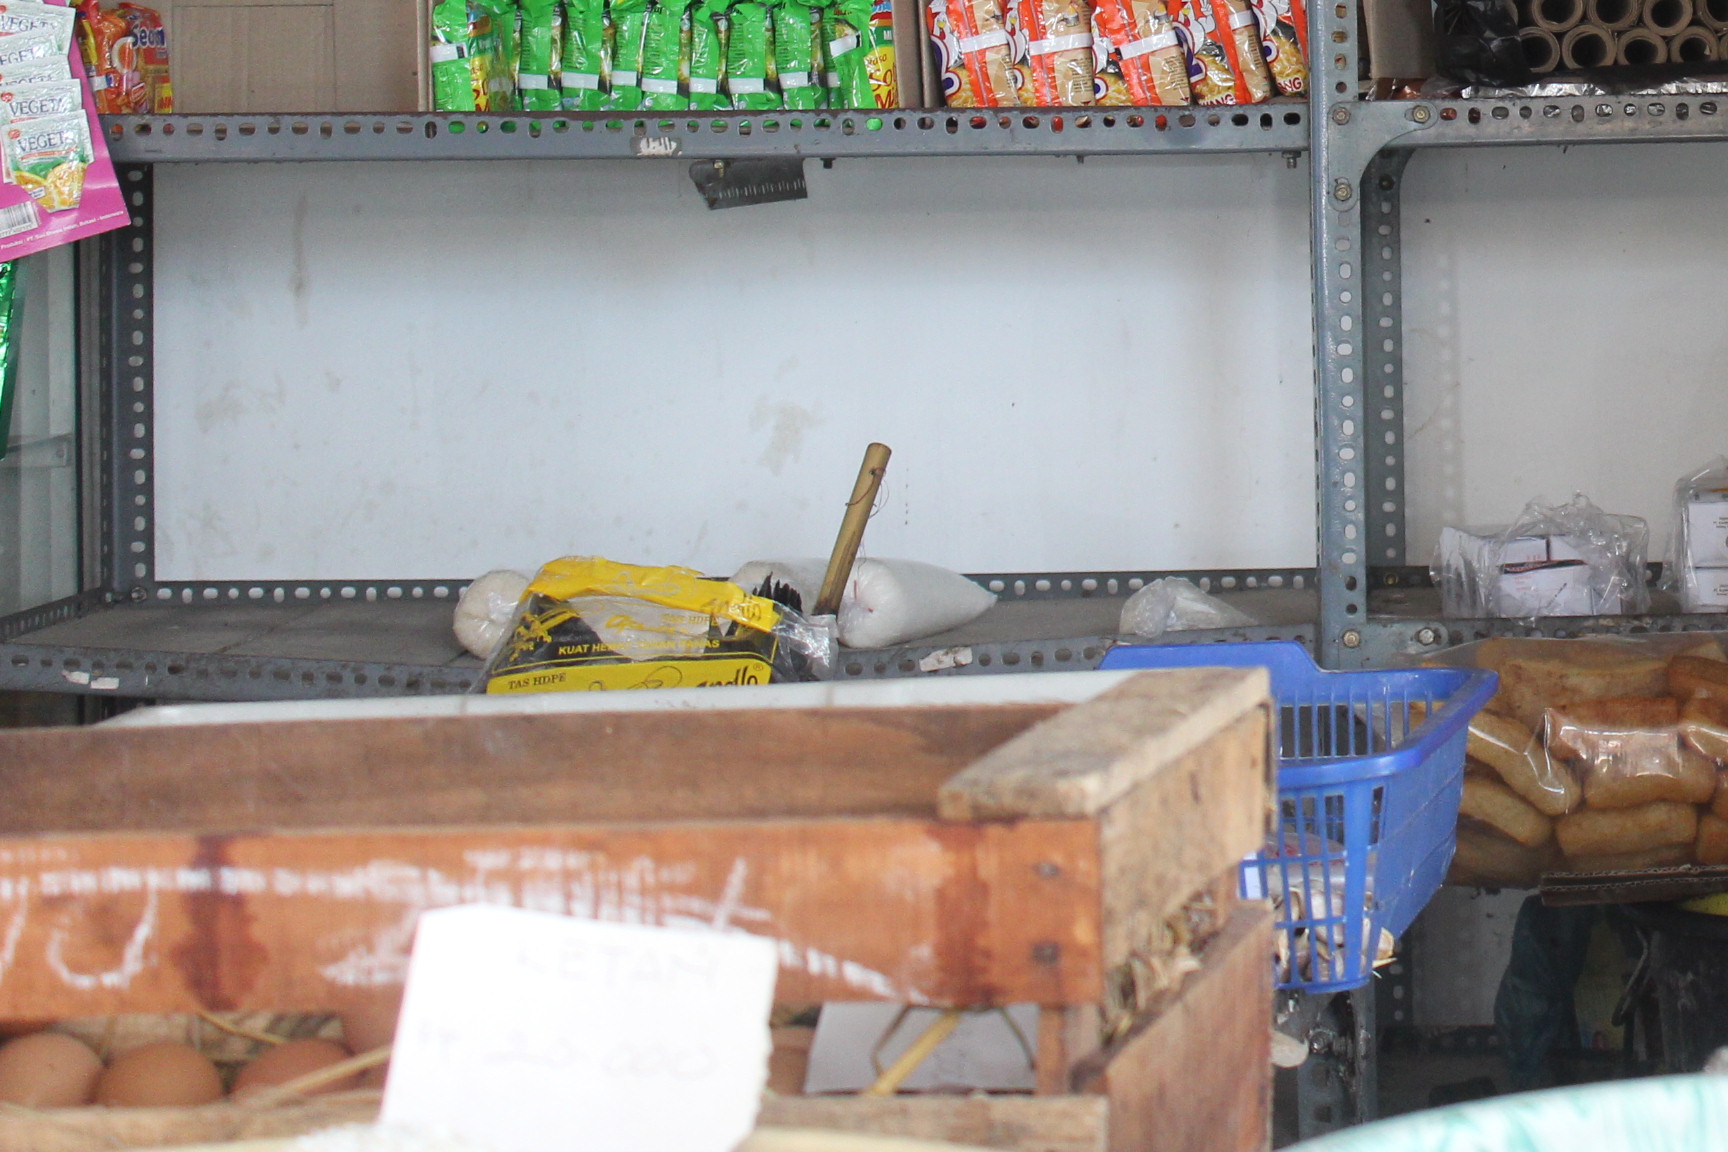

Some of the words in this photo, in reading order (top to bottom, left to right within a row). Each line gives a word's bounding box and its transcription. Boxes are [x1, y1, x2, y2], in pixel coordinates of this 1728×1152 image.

[17, 129, 74, 153] VEGET
[558, 643, 592, 655] KUAT
[508, 679, 532, 690] TAS
[534, 672, 567, 686] HDPE
